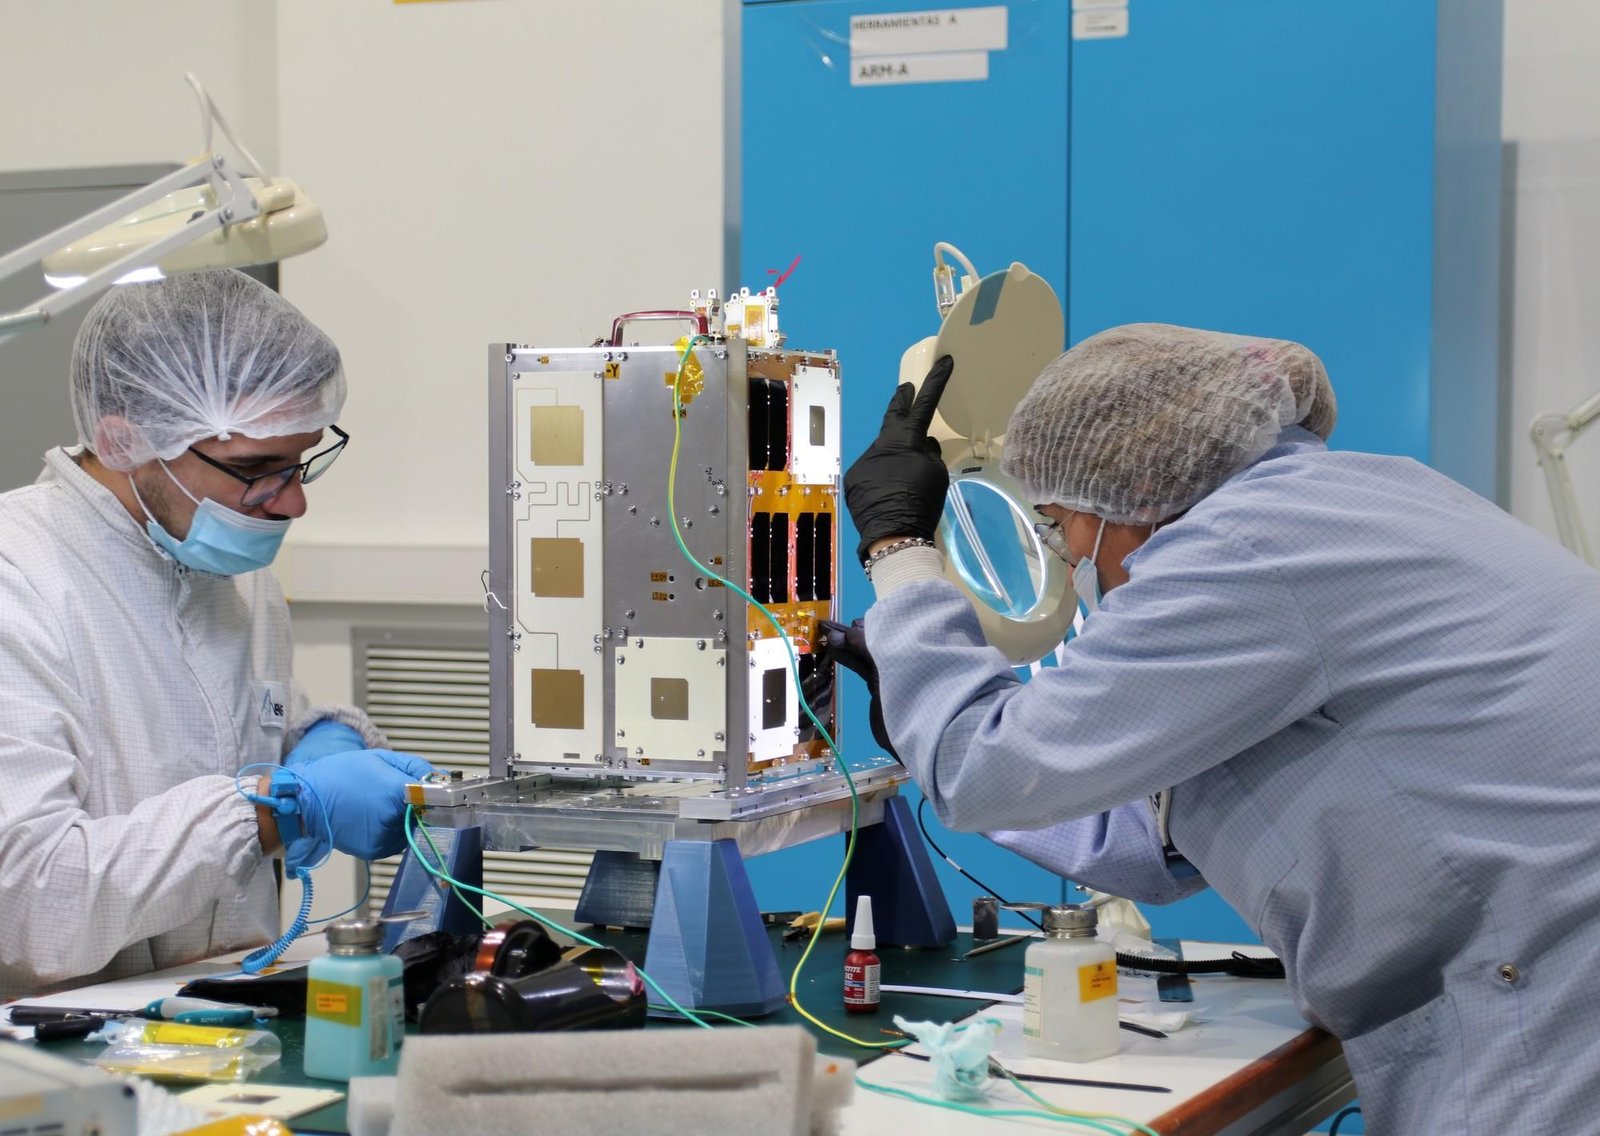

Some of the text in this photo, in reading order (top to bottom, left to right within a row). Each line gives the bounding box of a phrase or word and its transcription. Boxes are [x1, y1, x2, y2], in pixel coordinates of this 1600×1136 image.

[948, 13, 957, 25] A
[859, 62, 908, 78] ARM-A
[606, 363, 619, 378] -Y
